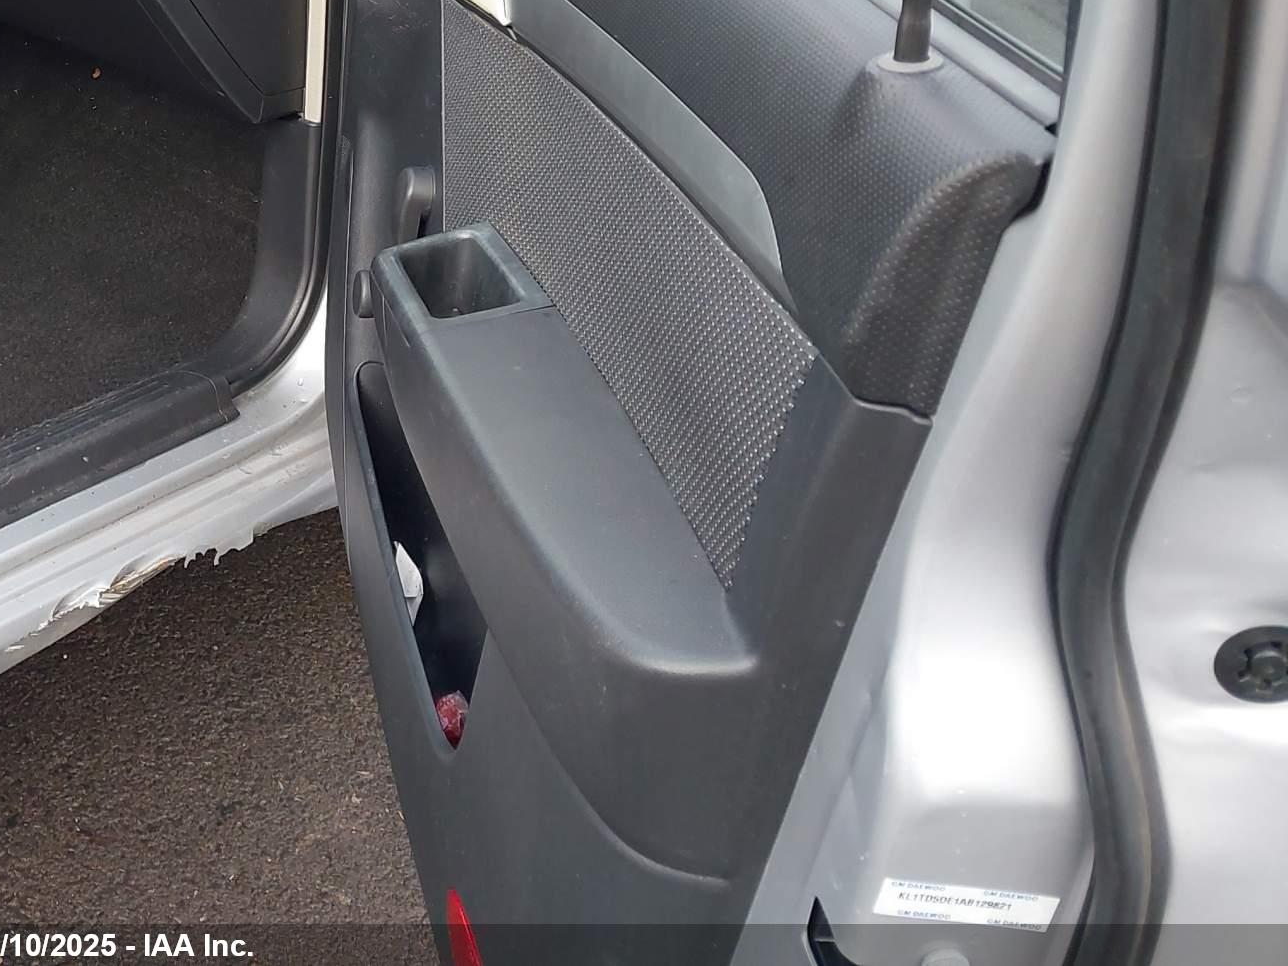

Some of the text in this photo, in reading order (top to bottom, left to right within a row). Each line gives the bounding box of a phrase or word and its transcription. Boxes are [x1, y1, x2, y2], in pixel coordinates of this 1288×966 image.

[907, 883, 946, 891] DAEWOO
[999, 892, 1039, 902] DAEWOO
[913, 911, 952, 920] DAEWOO
[1002, 921, 1042, 931] DAEWOO
